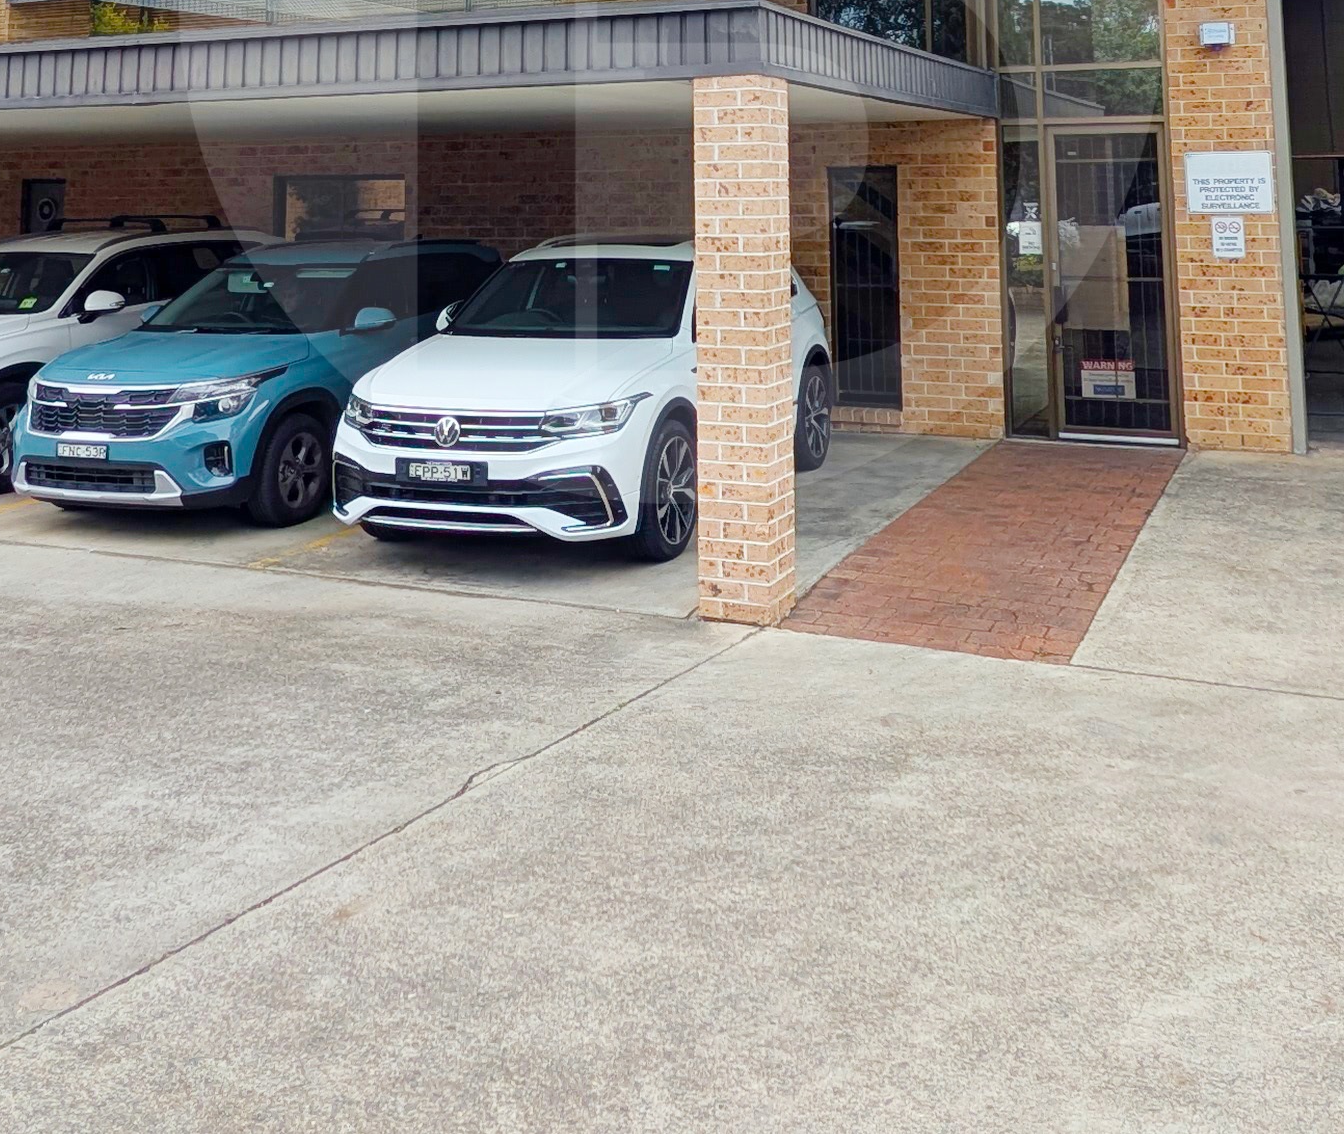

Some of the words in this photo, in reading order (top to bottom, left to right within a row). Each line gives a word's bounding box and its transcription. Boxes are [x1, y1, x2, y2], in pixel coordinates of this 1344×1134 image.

[1213, 177, 1255, 185] PROPERTY
[1258, 177, 1266, 185] IS
[1199, 185, 1246, 193] PROTECTED
[1248, 185, 1259, 193] BY
[1201, 202, 1261, 210] SURVEILLANCE
[1081, 360, 1133, 371] WARNNG
